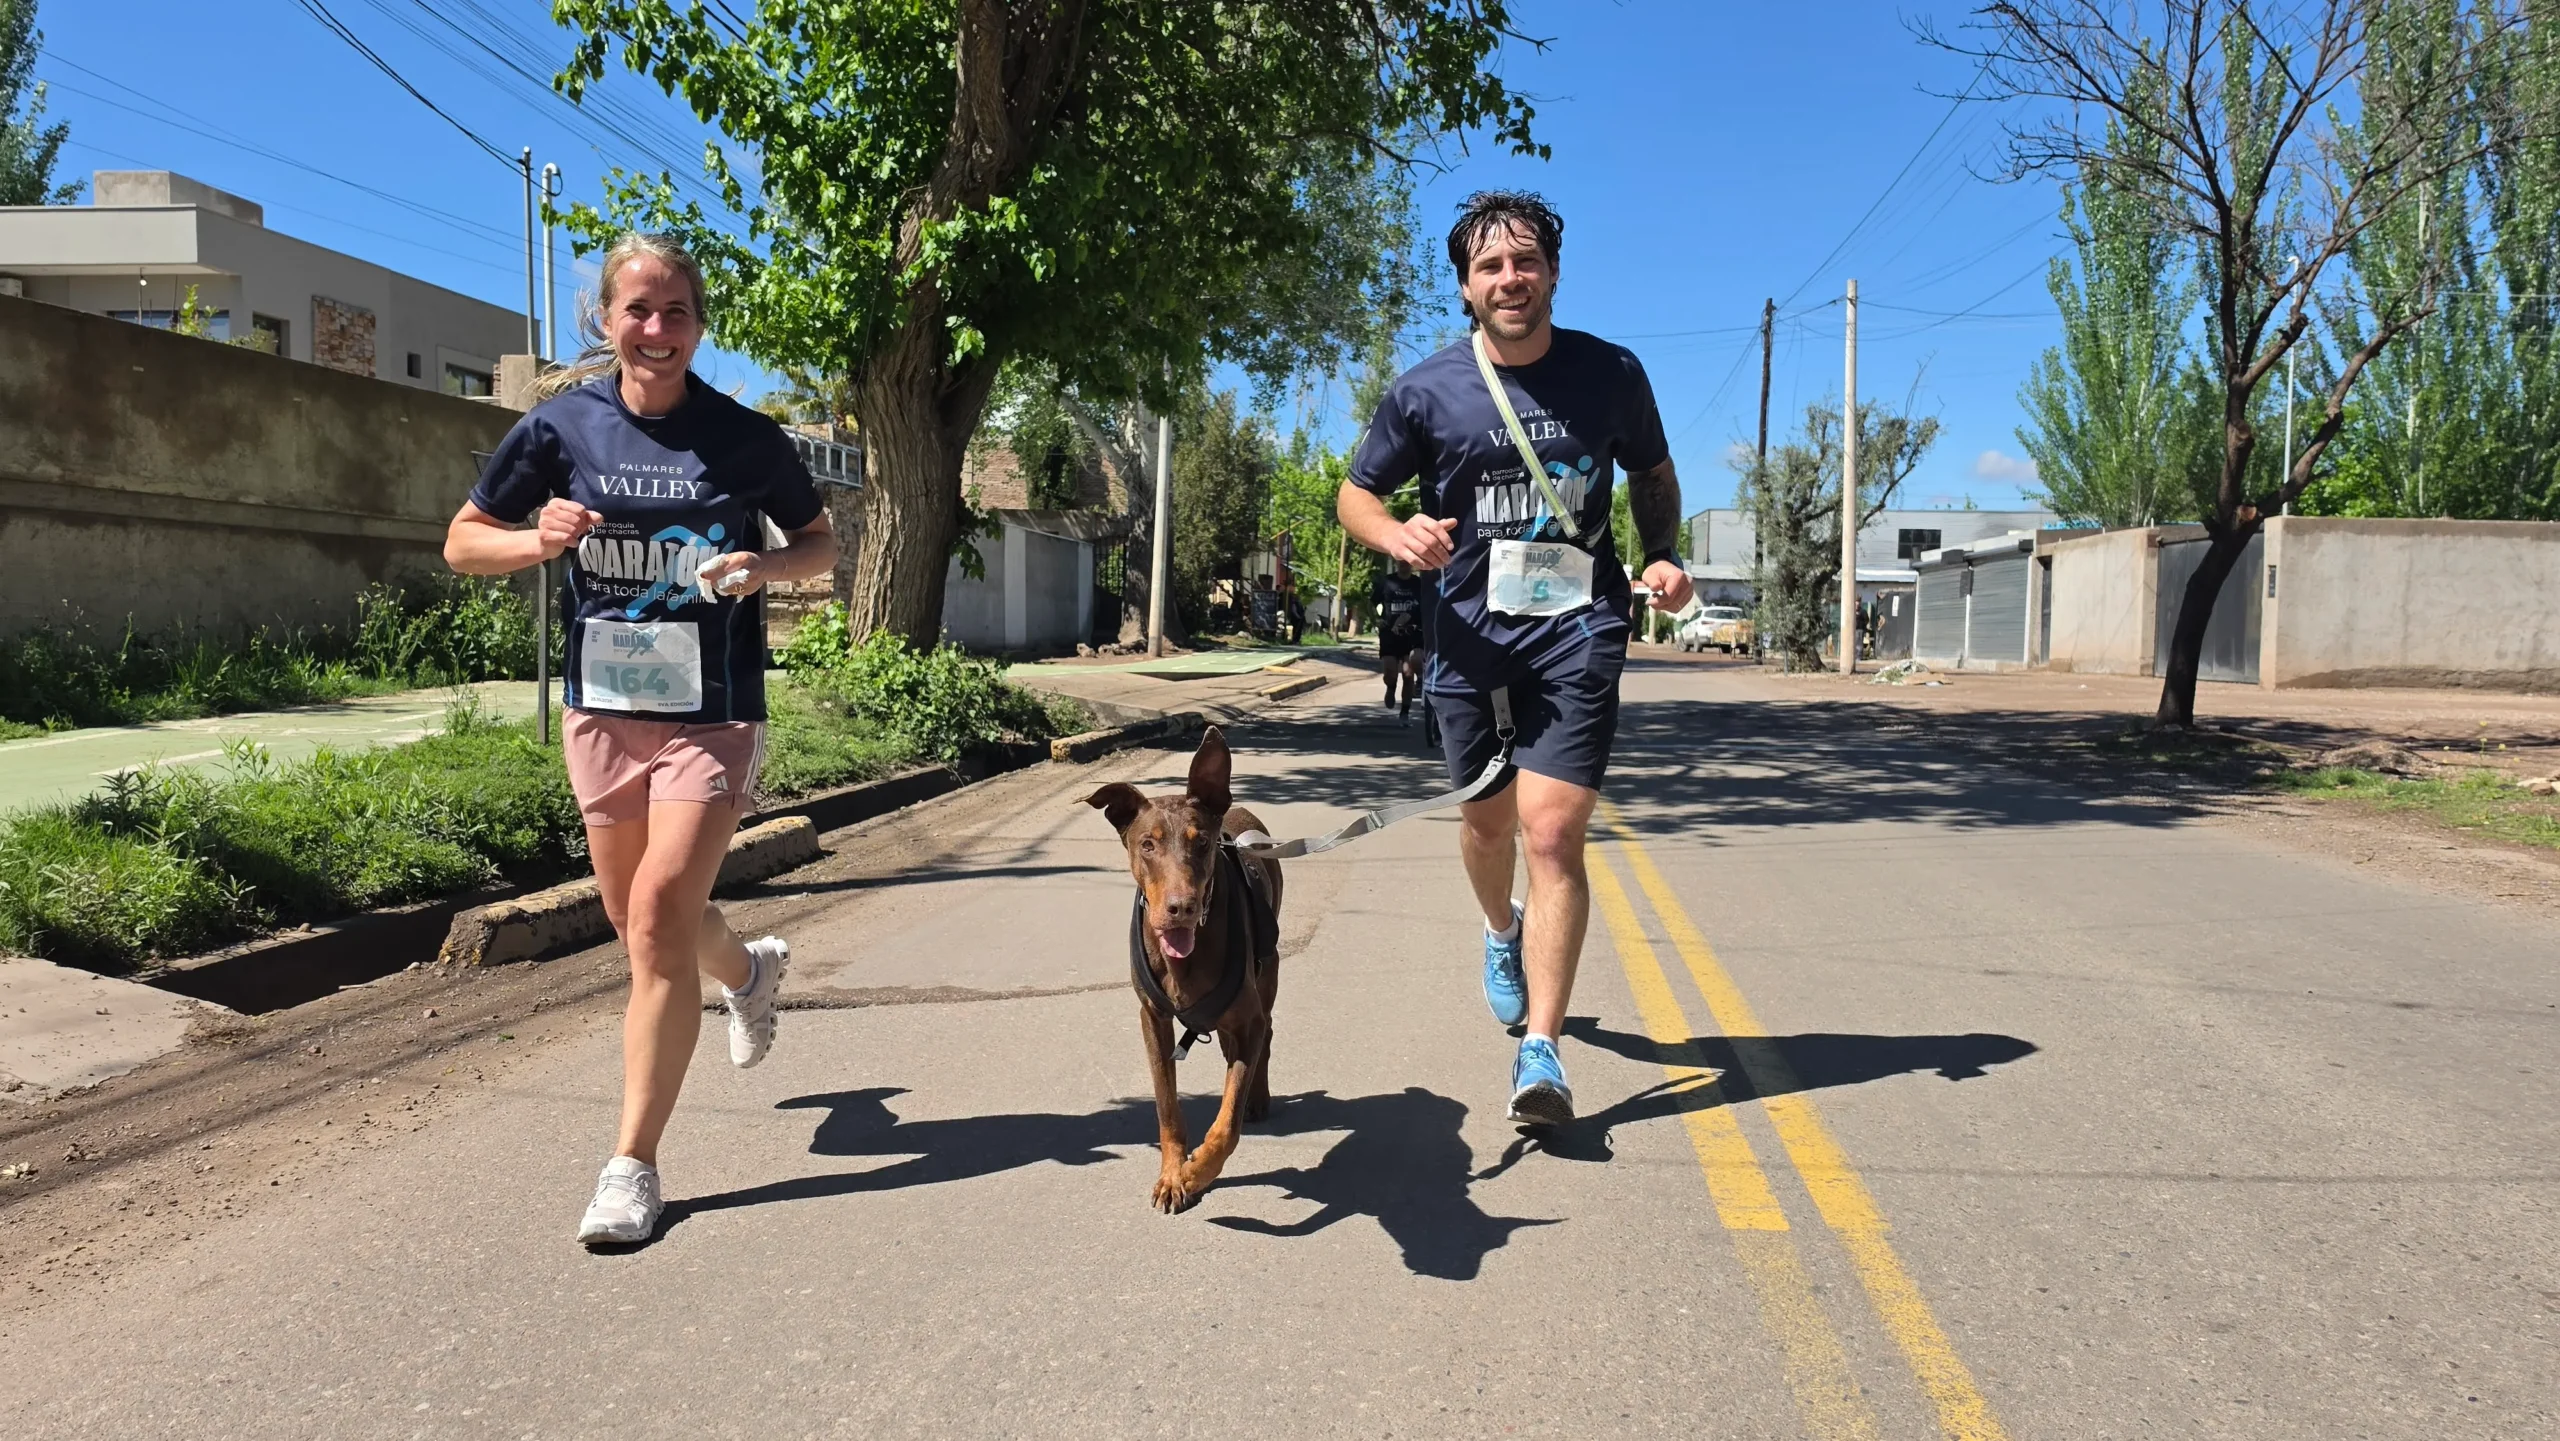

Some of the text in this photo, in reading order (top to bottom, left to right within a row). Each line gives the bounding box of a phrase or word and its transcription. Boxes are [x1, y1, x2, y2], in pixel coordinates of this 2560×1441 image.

[1517, 408, 1553, 420] MARES
[1488, 420, 1570, 447] VALEY
[619, 463, 683, 475] PALMARES
[1491, 466, 1521, 476] parroquia
[597, 475, 703, 500] VALLEY
[596, 521, 635, 530] parroquia
[1477, 524, 1503, 540] para
[586, 576, 611, 595] para
[613, 584, 649, 598] toda
[1530, 580, 1550, 602] 5
[604, 665, 670, 695] 164
